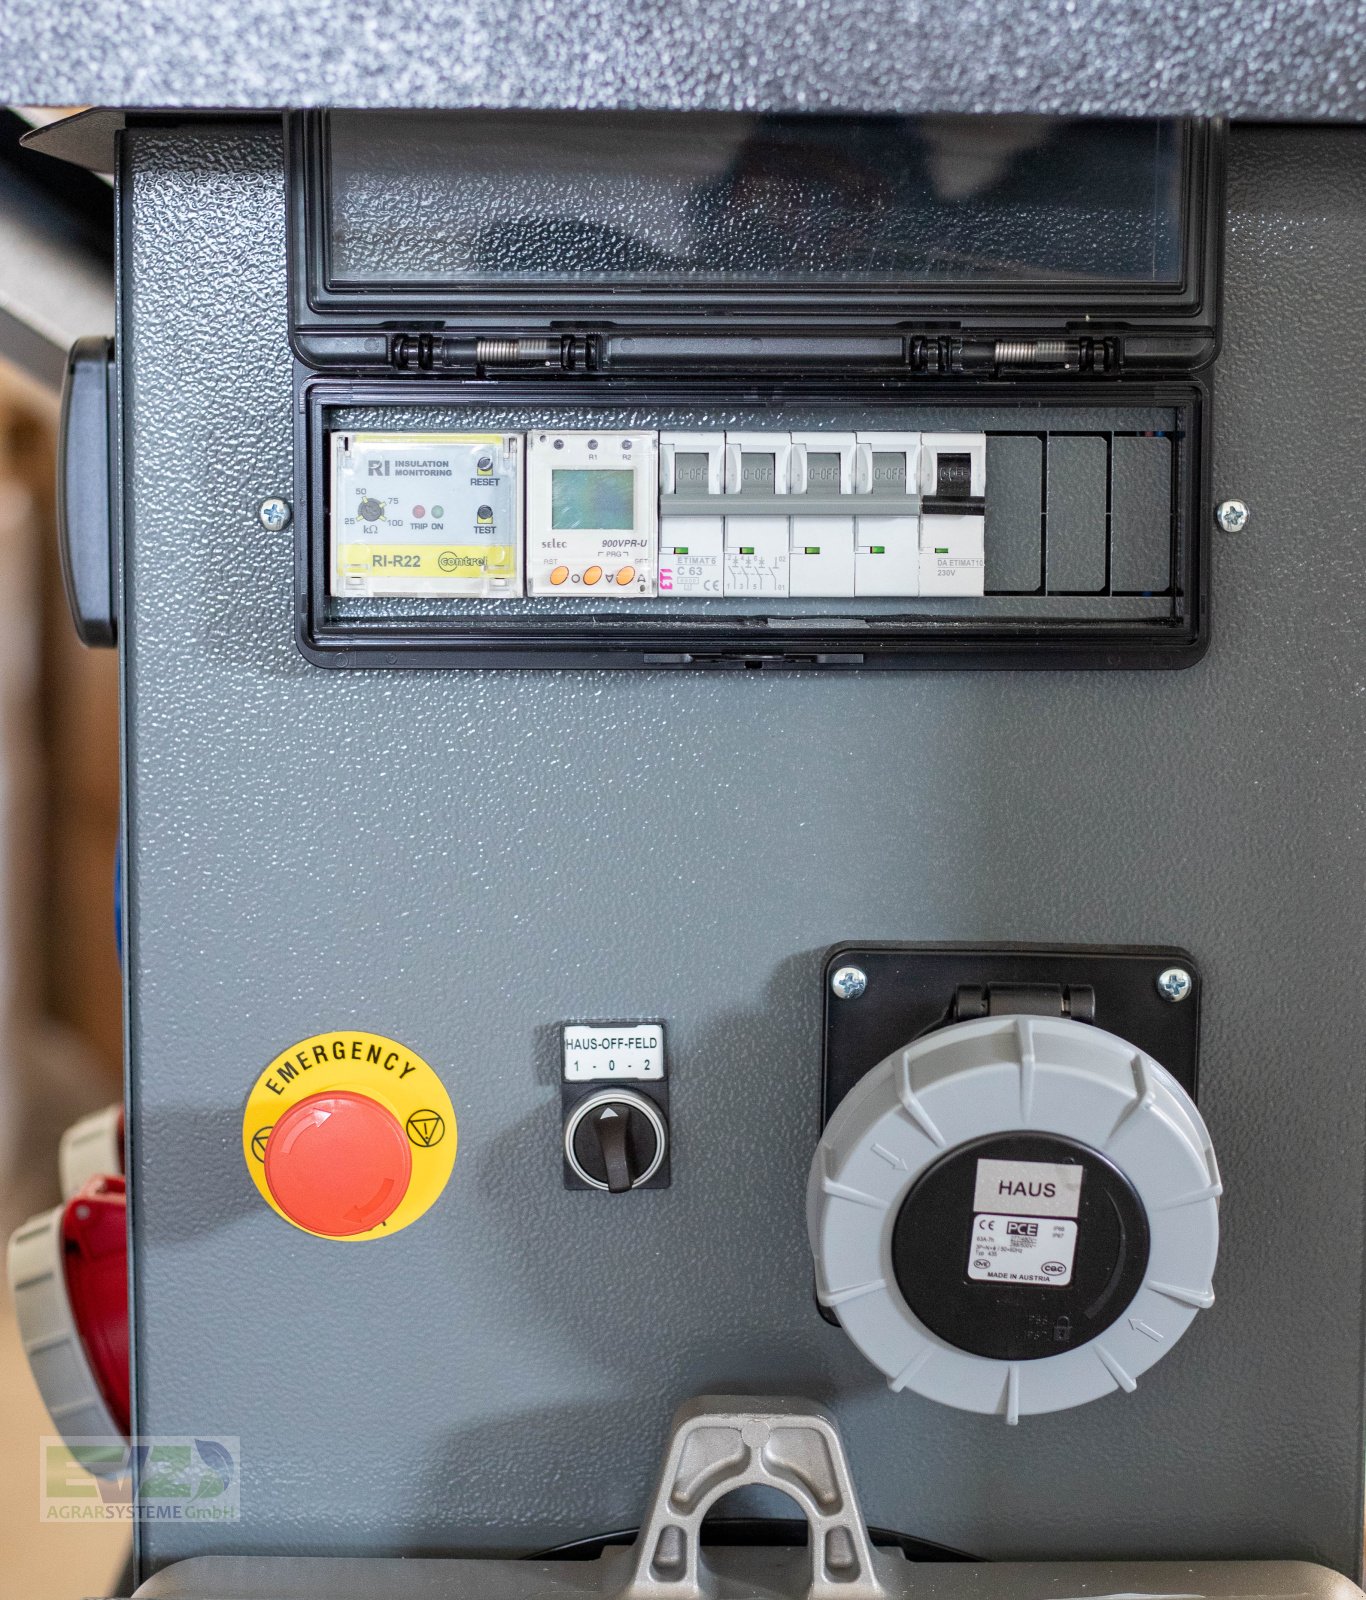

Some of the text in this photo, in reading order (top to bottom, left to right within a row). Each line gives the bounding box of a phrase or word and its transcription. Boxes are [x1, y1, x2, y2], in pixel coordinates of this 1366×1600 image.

[368, 460, 390, 476] RI
[395, 460, 449, 468] INSULATION
[394, 469, 452, 477] MONITORING
[470, 478, 500, 486] RESET
[473, 526, 496, 534] TEST
[602, 539, 647, 547] 900VPR-U
[372, 555, 421, 567] RI-R22
[677, 567, 702, 575] C 63
[660, 569, 673, 590] ETI
[566, 1037, 657, 1050] HAUS-OFF-FELD
[265, 1041, 416, 1095] EMERGENCY
[574, 1060, 579, 1072] 1
[609, 1060, 615, 1071] 0
[644, 1059, 650, 1070] 2
[998, 1180, 1056, 1198] HAUS
[1008, 1222, 1038, 1236] PCE
[1019, 1274, 1050, 1282] AUSTRIA
